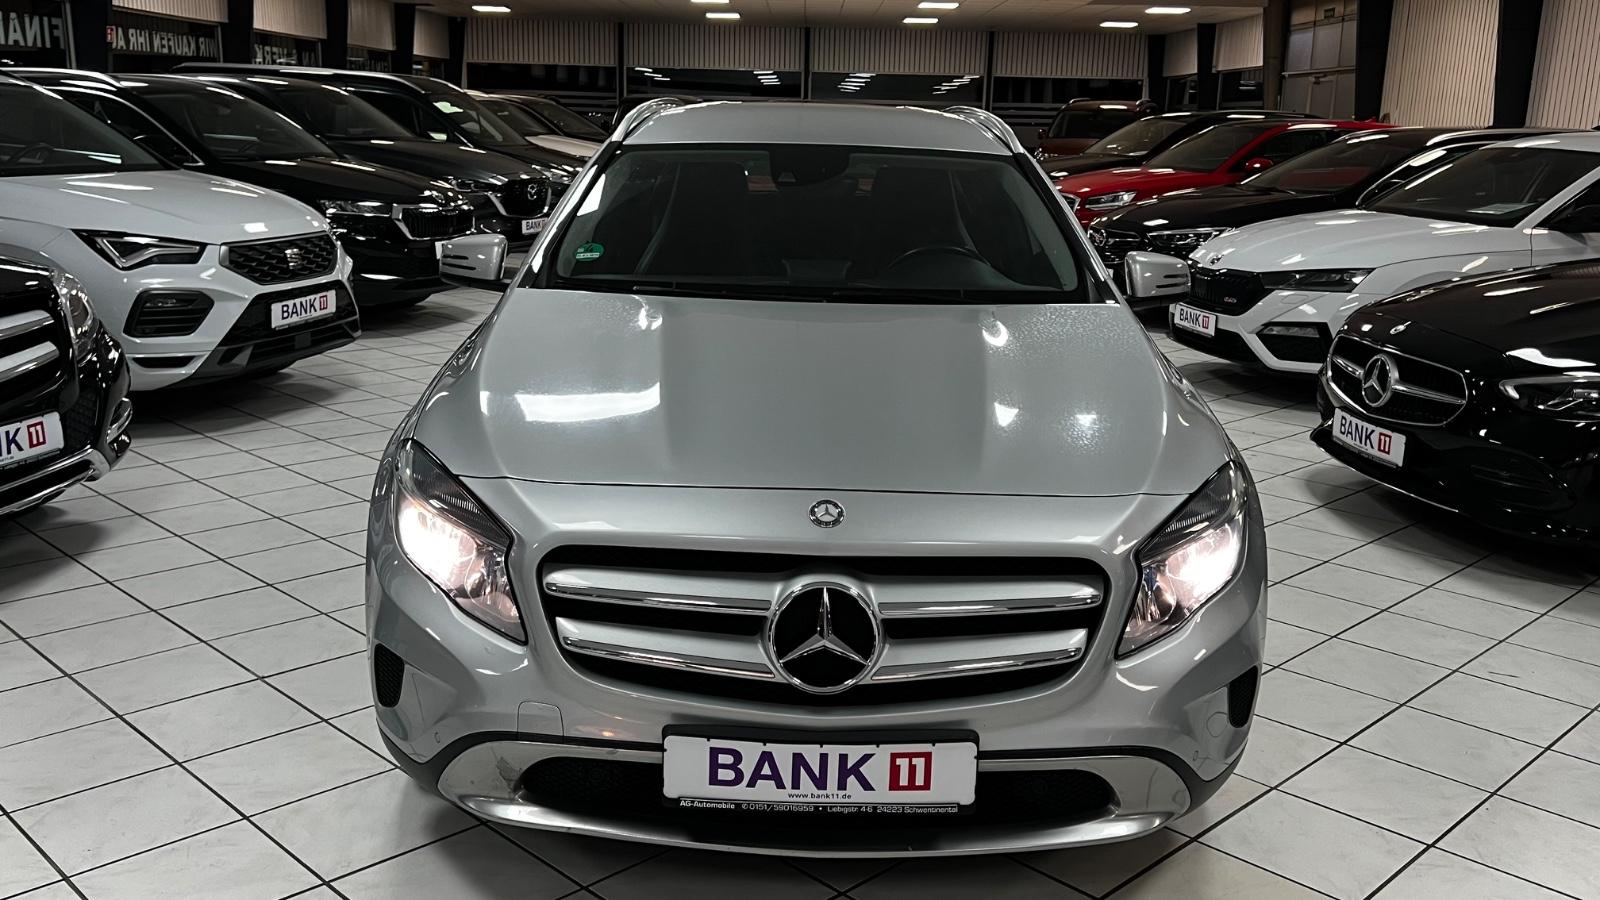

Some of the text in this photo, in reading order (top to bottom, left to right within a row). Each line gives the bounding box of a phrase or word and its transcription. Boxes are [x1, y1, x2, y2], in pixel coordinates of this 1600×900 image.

[281, 296, 327, 320] BANK 11
[1180, 308, 1201, 327] BANK
[28, 423, 45, 446] 11
[1340, 415, 1375, 449] BANK
[1379, 433, 1391, 454] 11
[708, 747, 928, 791] BANK 11
[679, 800, 735, 809] AG-Automobile
[787, 791, 852, 800] www.bank11.de
